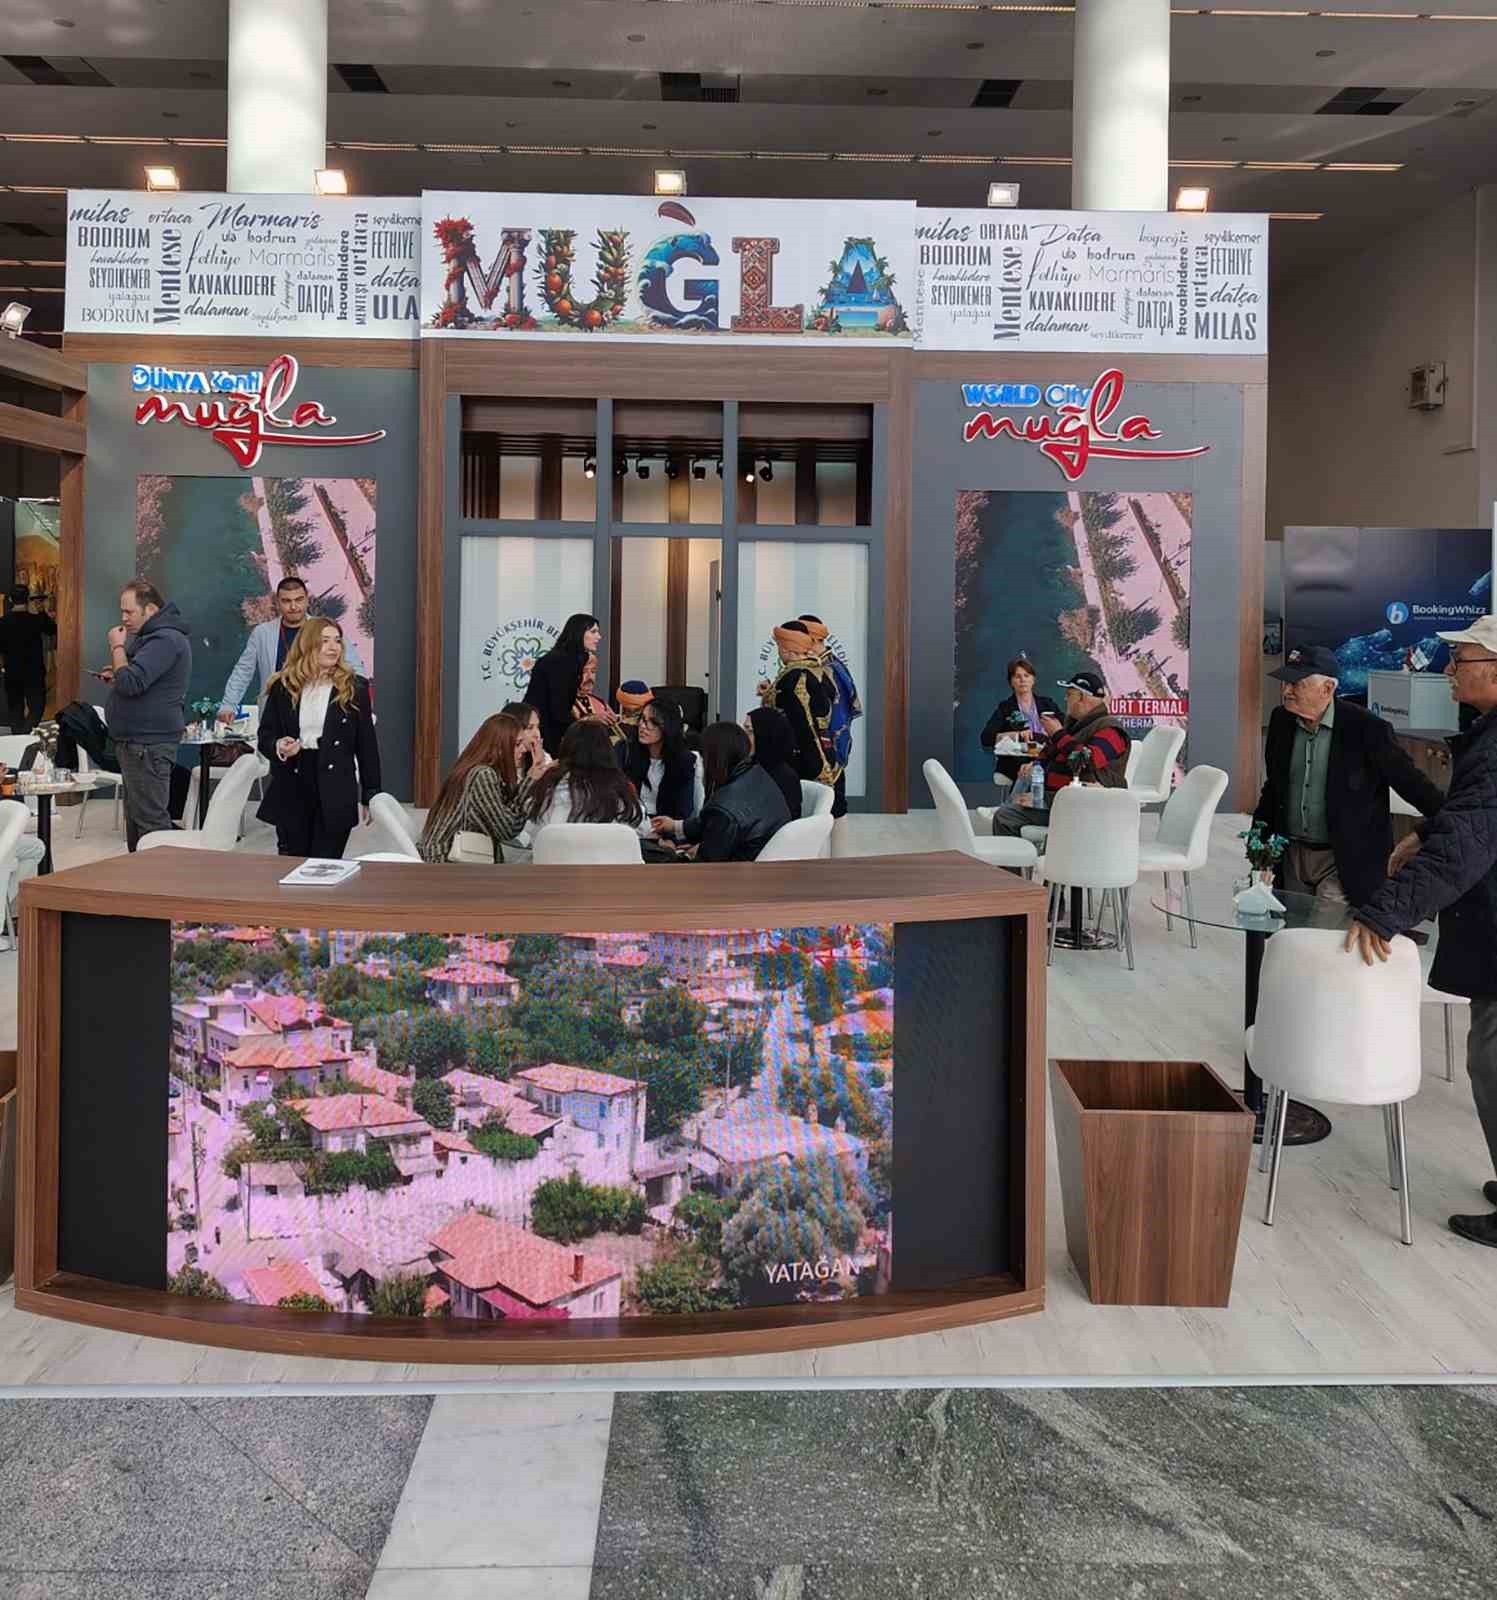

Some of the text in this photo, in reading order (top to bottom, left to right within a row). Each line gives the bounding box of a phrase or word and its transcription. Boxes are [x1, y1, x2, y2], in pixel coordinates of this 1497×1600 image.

[69, 198, 134, 224] milas
[148, 208, 193, 225] ortaca
[200, 202, 323, 231] Marmaris
[373, 213, 422, 229] seydikeme
[78, 226, 151, 249] BODRUM
[247, 229, 296, 244] bodrum
[914, 217, 974, 242] milas
[979, 223, 1029, 241] ORTACA
[1030, 223, 1103, 246] Datça
[352, 213, 369, 276] ortaca
[920, 244, 992, 266] BODRUM
[1087, 247, 1136, 261] bodrum
[248, 248, 336, 267] Marmaris
[432, 201, 912, 334] MUĞLA
[188, 274, 277, 296] KAVAKLIDERE
[370, 265, 422, 291] datça
[1088, 265, 1175, 284] Marmaris
[1192, 246, 1209, 308] ortaca
[298, 284, 335, 321] DATÇA
[1029, 291, 1116, 312] KAVAKLIDERE
[1210, 281, 1262, 308] datça
[81, 307, 149, 323] BODRUM
[184, 297, 250, 317] dalaman
[373, 295, 421, 320] ULA
[1137, 300, 1174, 336] DATÇA
[1024, 313, 1090, 332] dalaman
[961, 383, 1041, 407] WORLD
[1412, 603, 1488, 616] BookingWhizz
[1137, 700, 1185, 714] TERMAL
[765, 1255, 860, 1284] YATAĞAN
